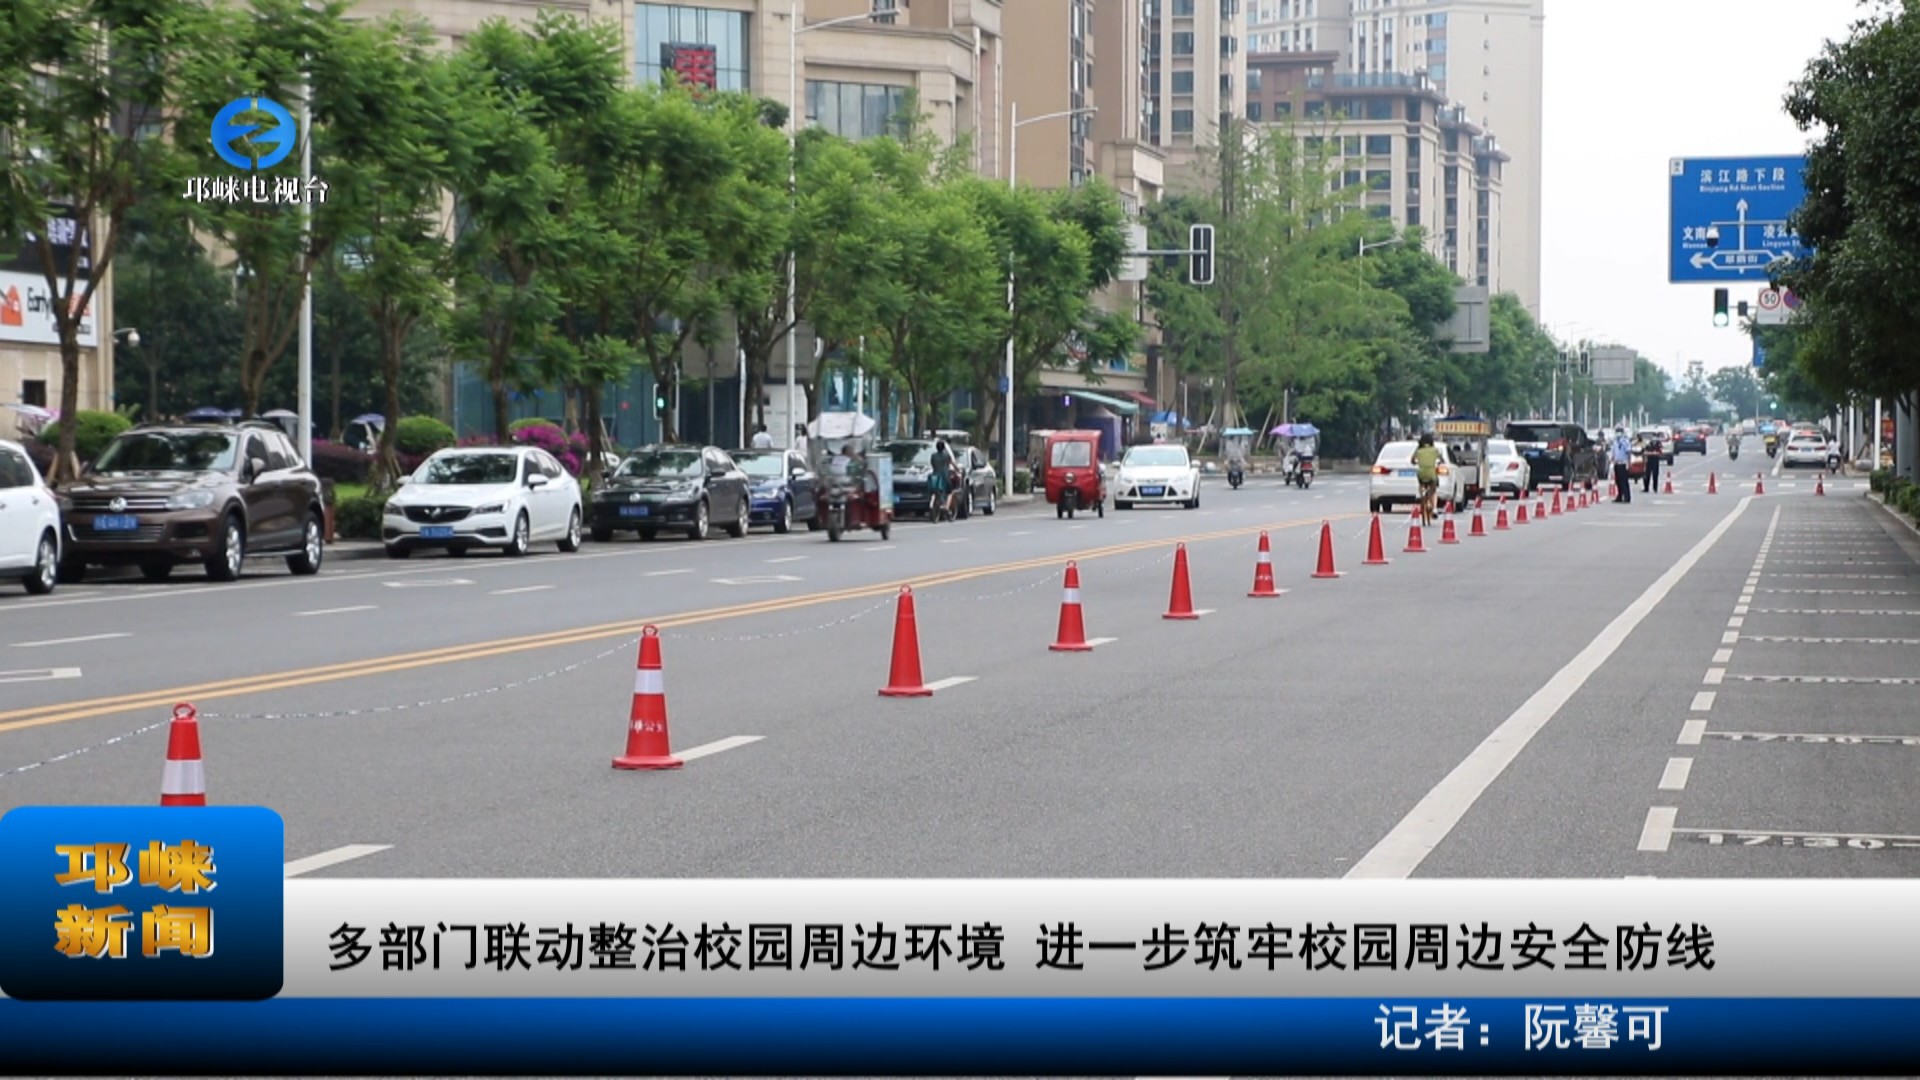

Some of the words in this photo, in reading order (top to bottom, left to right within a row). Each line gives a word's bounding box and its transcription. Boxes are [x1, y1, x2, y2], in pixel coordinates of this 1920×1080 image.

[1701, 167, 1785, 183] 滨江路下段
[1764, 293, 1776, 304] 50
